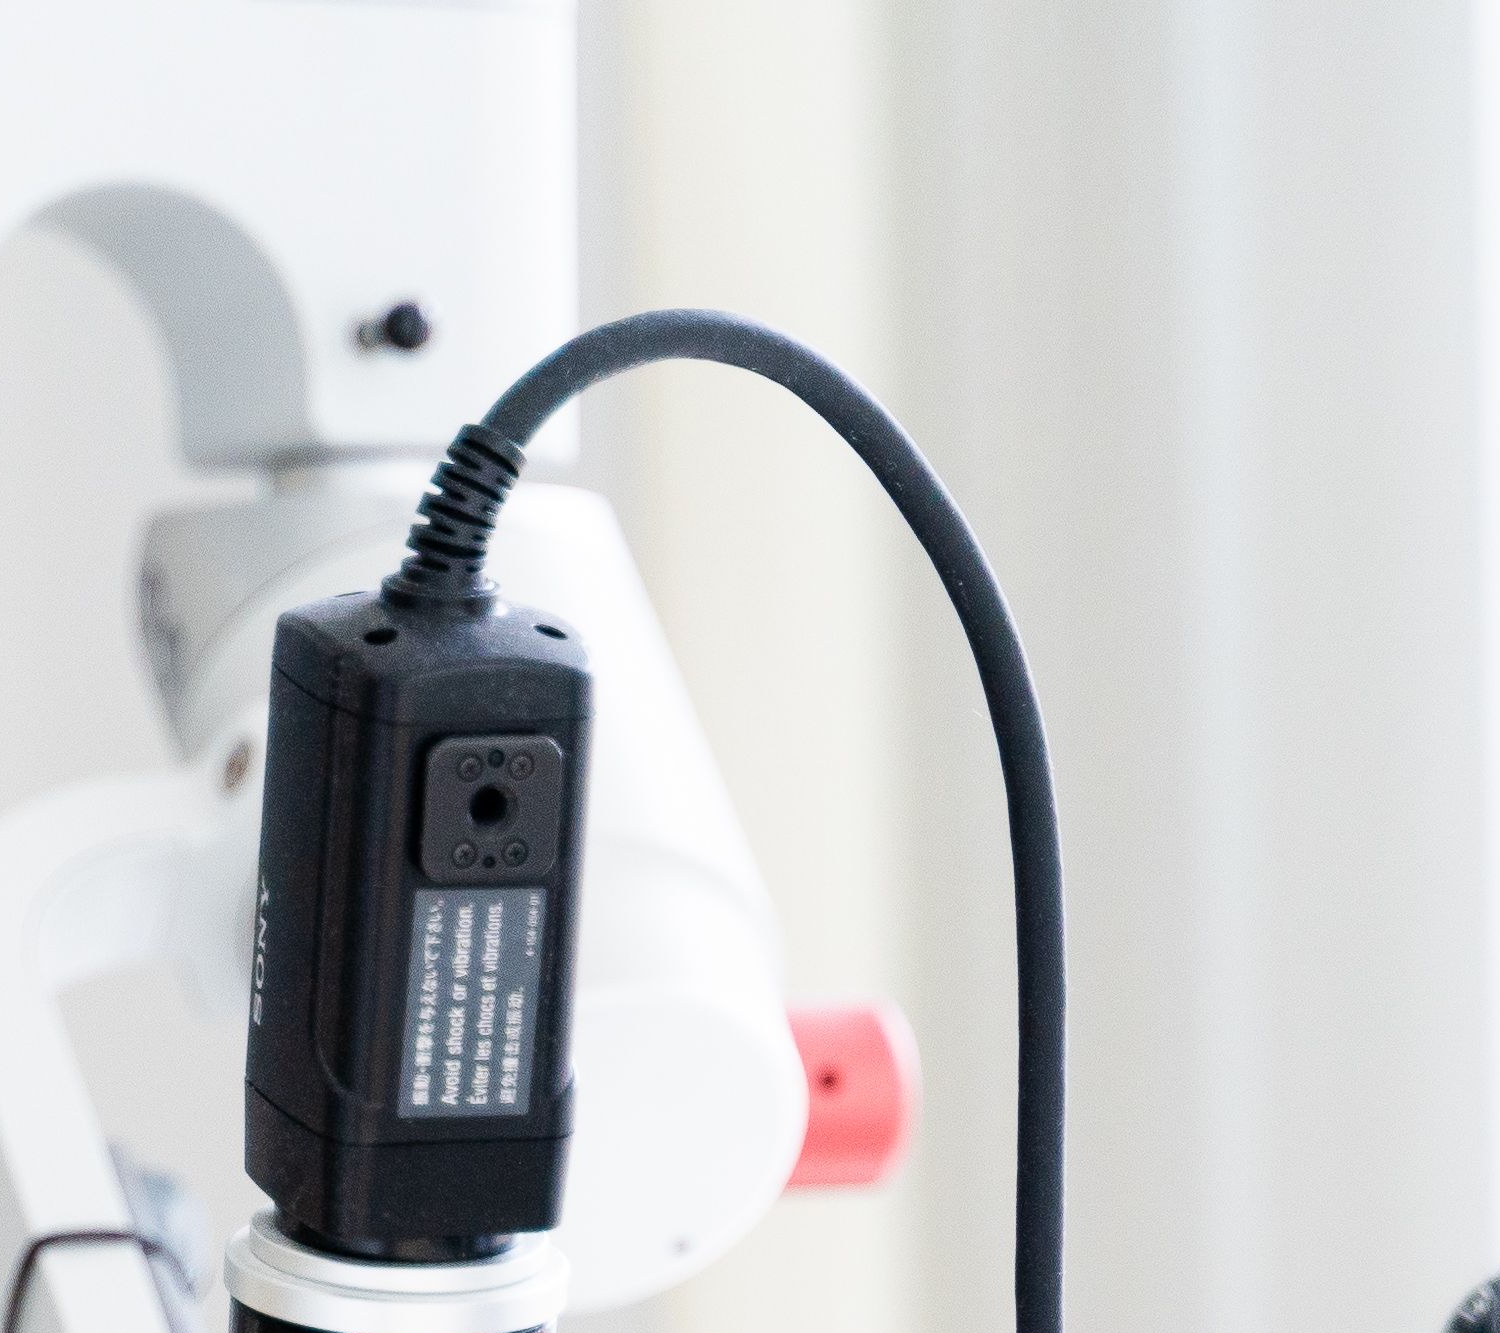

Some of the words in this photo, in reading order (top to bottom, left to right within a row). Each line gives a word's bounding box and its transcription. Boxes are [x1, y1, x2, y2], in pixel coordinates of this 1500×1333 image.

[253, 875, 270, 1026] SONY
[452, 902, 474, 977] vibration.
[482, 901, 503, 972] vibrations.
[452, 983, 468, 1000] or
[481, 976, 497, 990] et
[446, 1006, 466, 1055] shock
[477, 995, 495, 1035] chocs
[475, 1040, 492, 1060] les
[440, 1059, 462, 1105] Avoid
